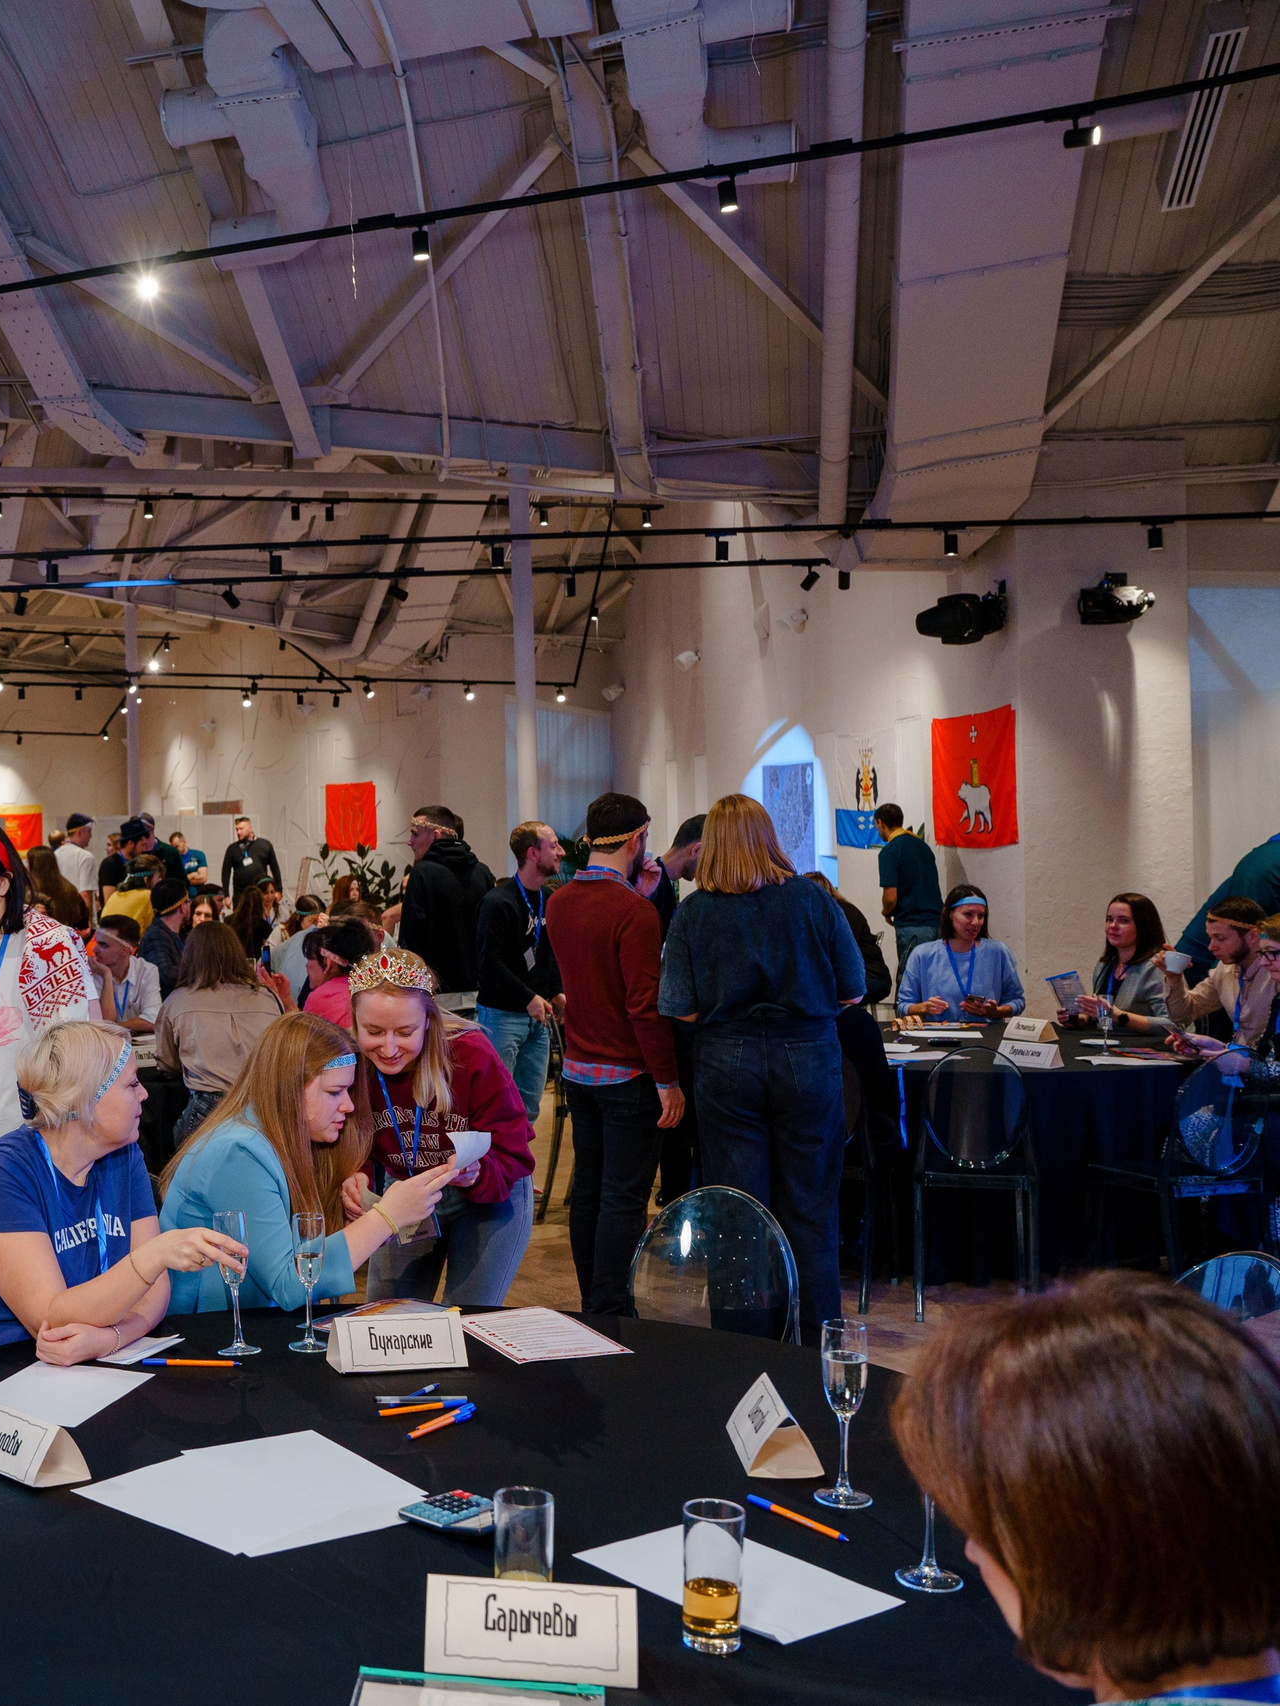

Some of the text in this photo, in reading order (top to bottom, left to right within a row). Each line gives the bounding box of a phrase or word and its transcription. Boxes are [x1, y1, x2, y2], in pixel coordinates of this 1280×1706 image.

[444, 1113, 470, 1132] TH
[368, 1326, 434, 1356] Бухарские
[484, 1593, 577, 1642] Сарычевы
